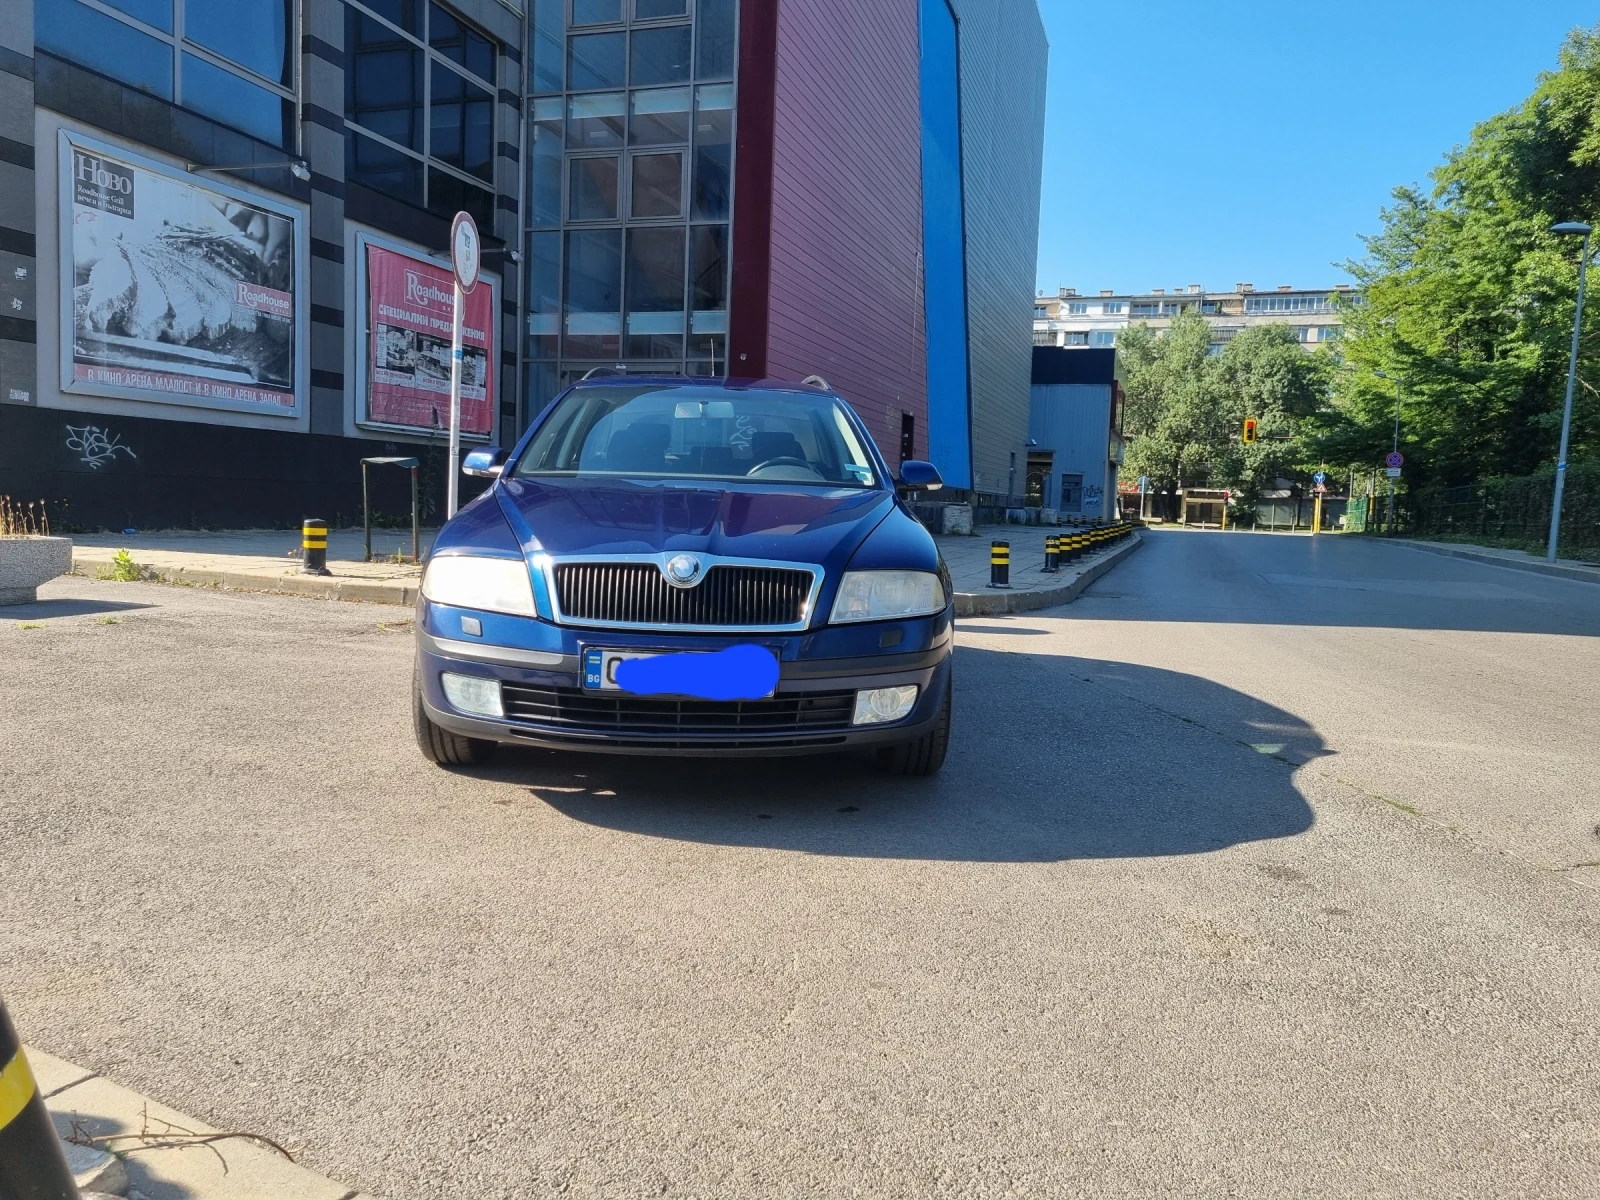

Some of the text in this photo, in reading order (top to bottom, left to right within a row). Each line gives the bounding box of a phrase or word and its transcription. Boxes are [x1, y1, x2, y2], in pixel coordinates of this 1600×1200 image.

[77, 184, 124, 205] Roadhouse Grill
[77, 195, 91, 203] вече
[102, 200, 132, 215] България
[237, 283, 289, 308] Roadhouse
[378, 304, 485, 341] СПЕЦИАЛНИ ПРЕДЛЖЕНИЯ
[88, 369, 281, 405] В КИНО АРЕНА МЛАДОСТ И В КИНО АРЕНА ЗАПАД
[587, 674, 600, 683] BG
